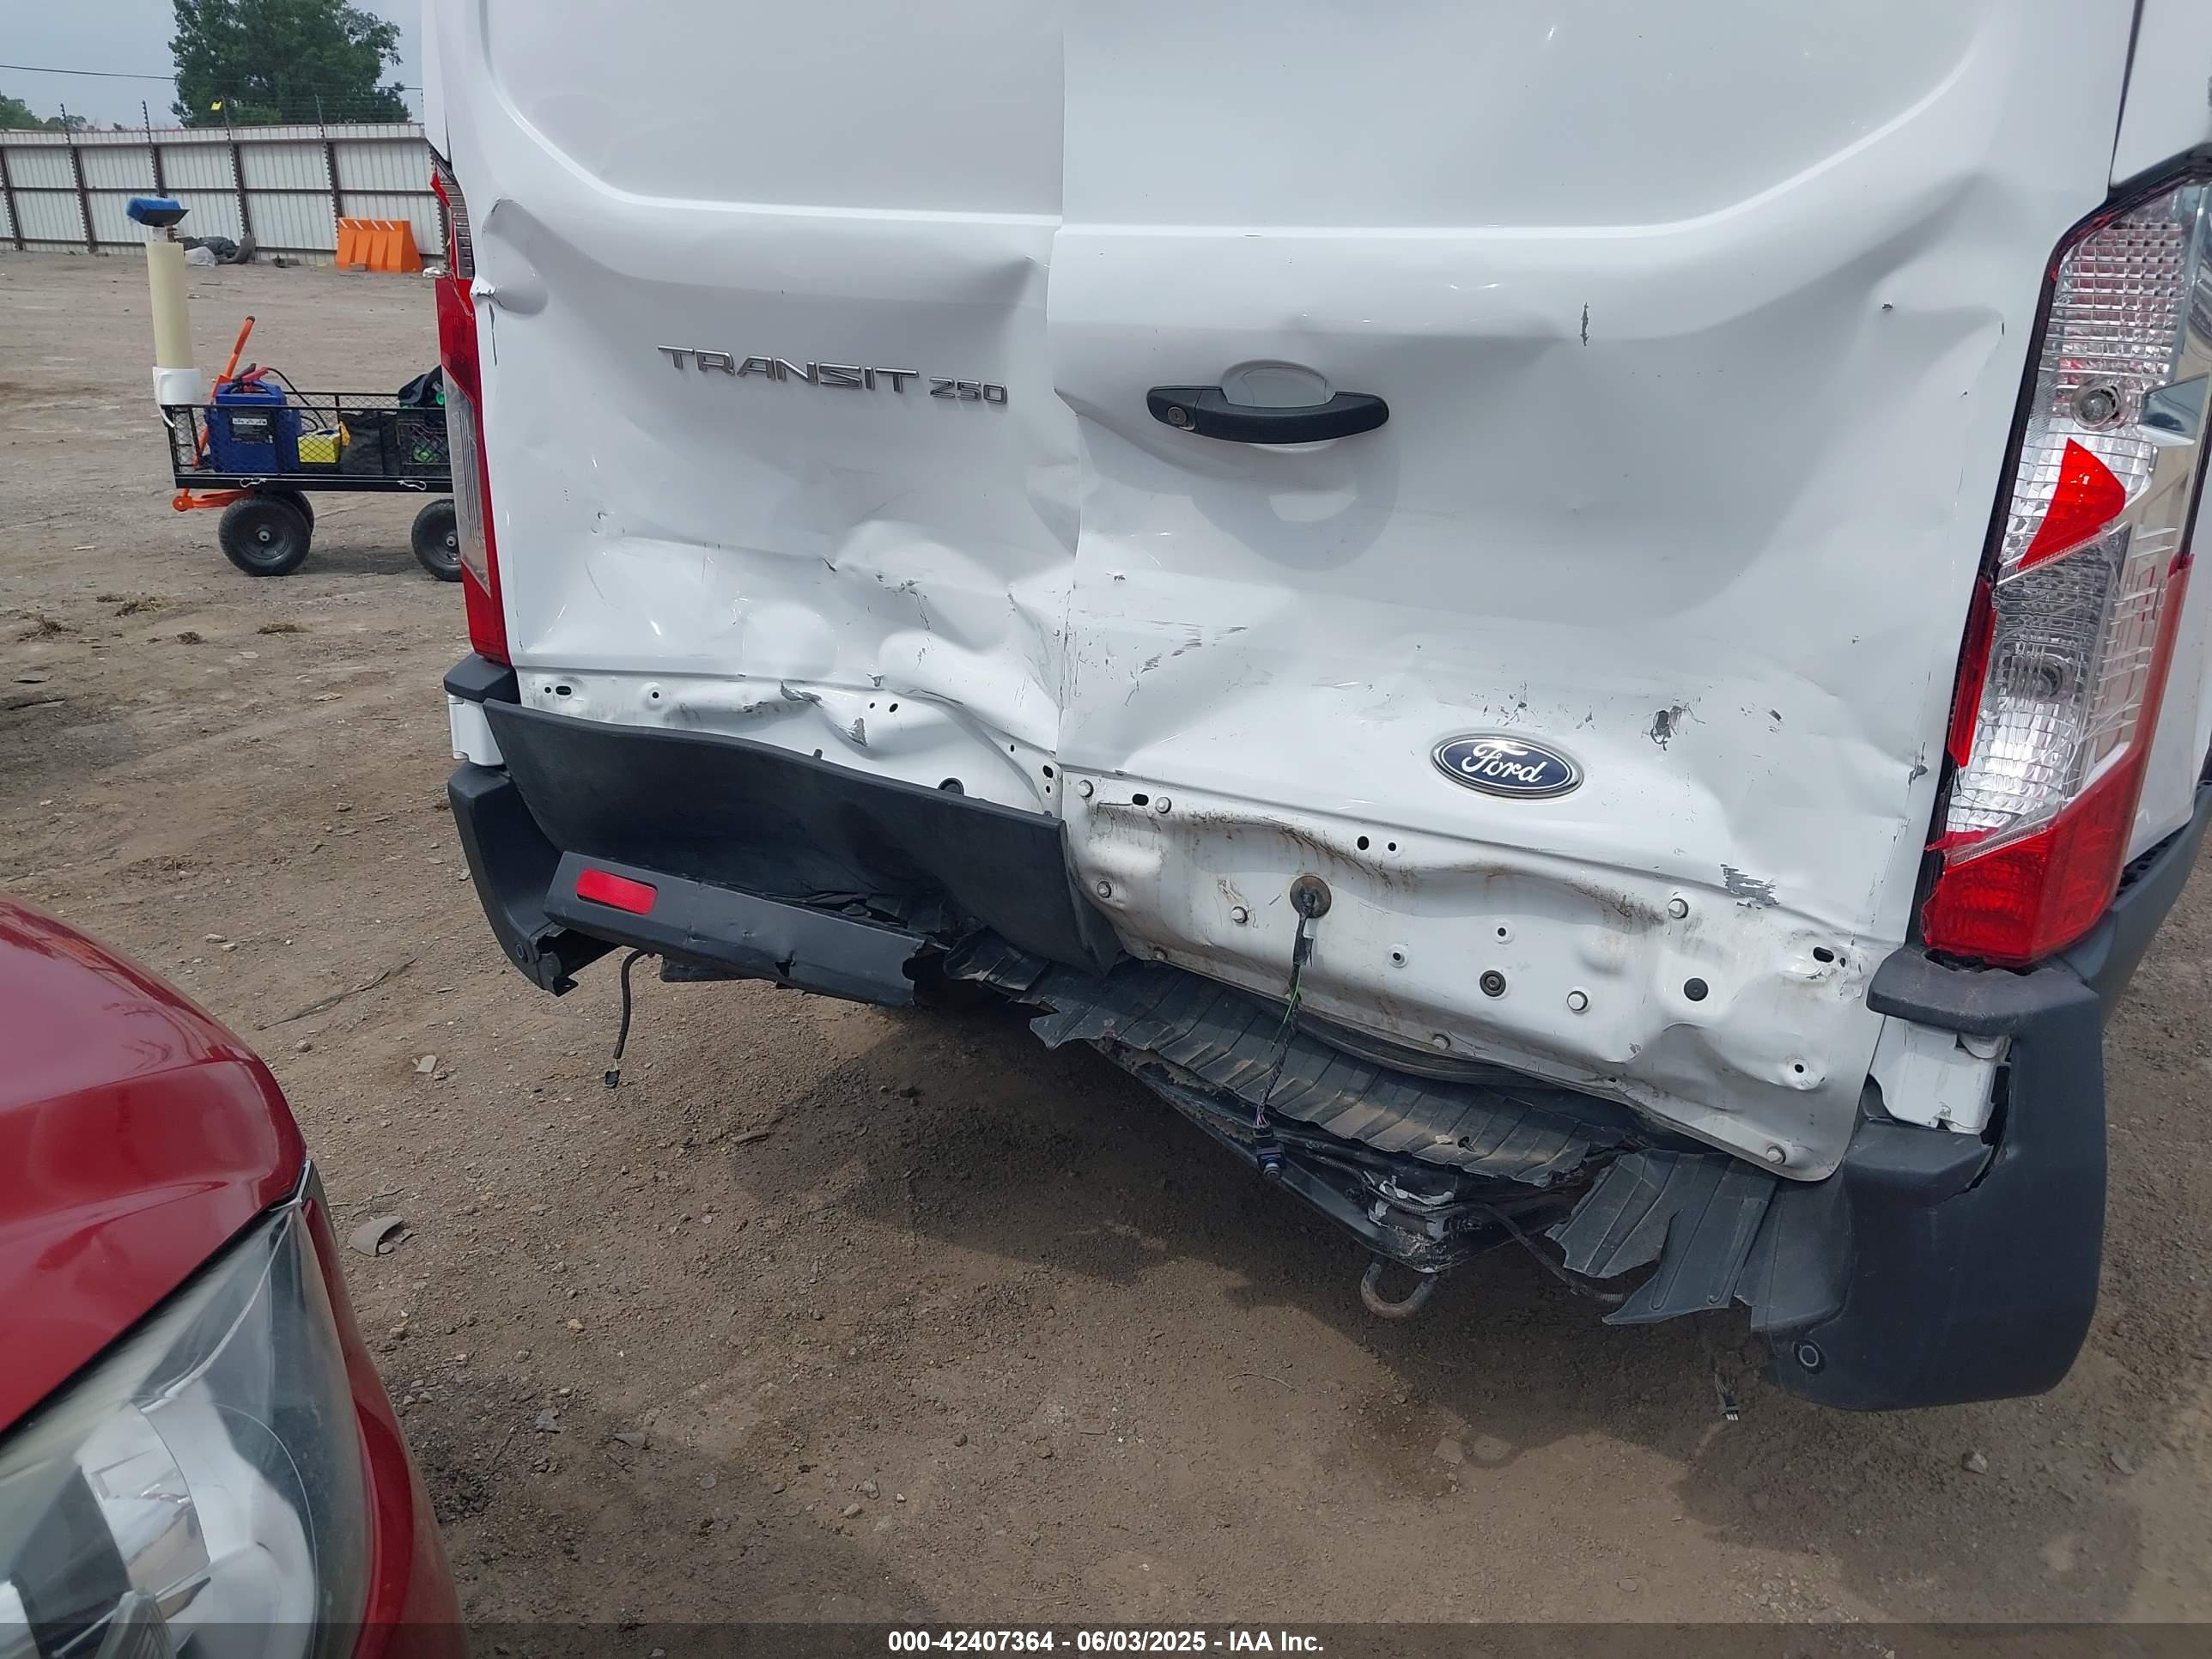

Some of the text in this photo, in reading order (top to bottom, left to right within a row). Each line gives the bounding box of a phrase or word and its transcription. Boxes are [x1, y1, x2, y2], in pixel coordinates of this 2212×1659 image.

[658, 344, 1008, 405] TRANSIT 250
[1462, 741, 1547, 783] Ford
